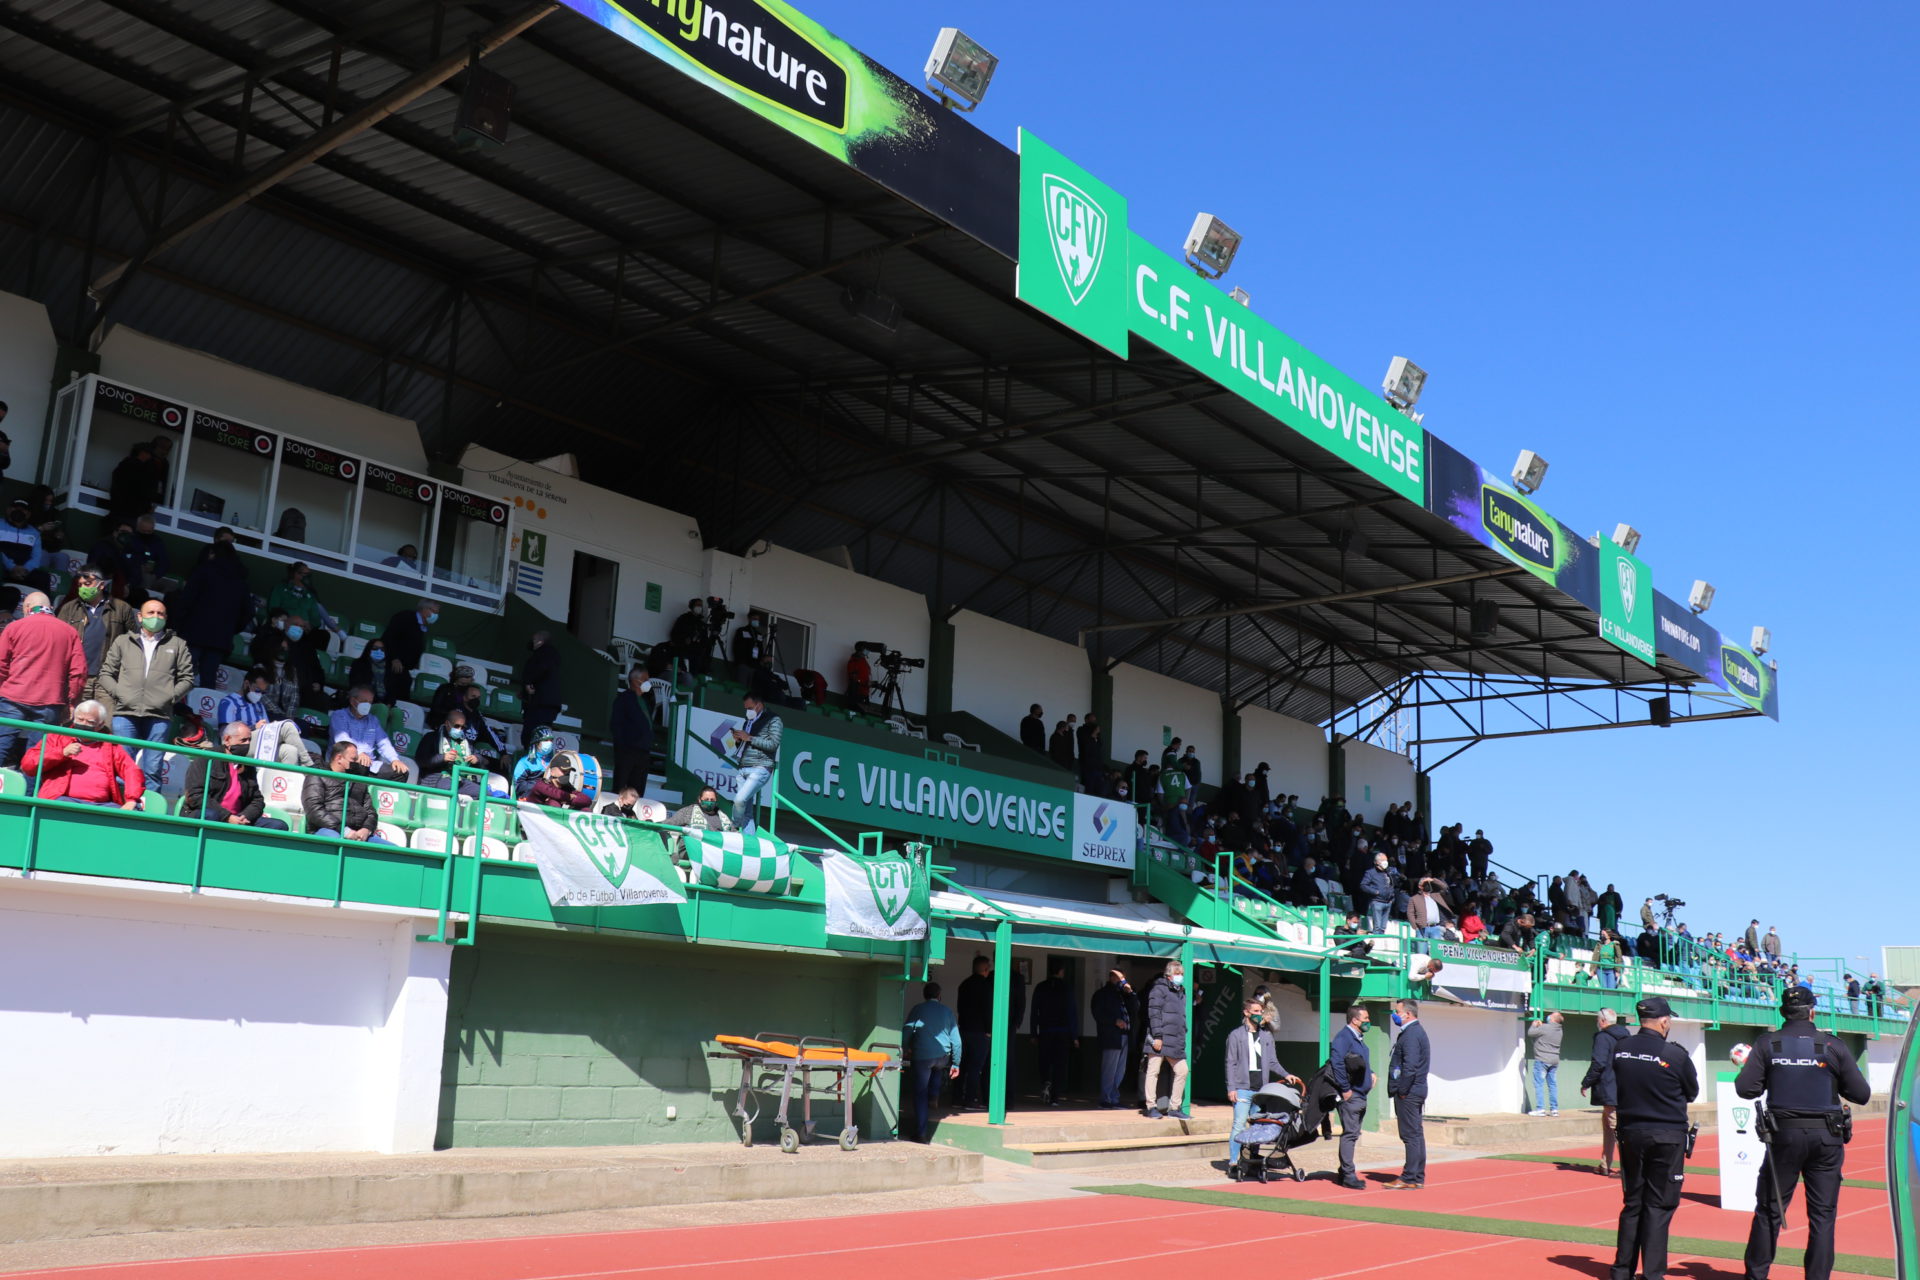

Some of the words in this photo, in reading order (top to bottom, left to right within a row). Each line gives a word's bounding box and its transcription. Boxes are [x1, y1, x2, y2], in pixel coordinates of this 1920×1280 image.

[1056, 191, 1098, 258] CFV
[1136, 264, 1194, 341] C.F.
[1204, 304, 1420, 483] VILLANOVENSE
[122, 403, 158, 423] STORE
[216, 432, 250, 450] STORE
[303, 458, 336, 476] STORE
[385, 483, 415, 498] STORE
[461, 504, 488, 519] STORE
[1490, 496, 1549, 558] tanynature
[1614, 624, 1654, 658] VILLANOVENSE
[694, 768, 738, 794] SEPR
[793, 751, 846, 799] C.F.
[858, 762, 1066, 841] VILLANOVENSE
[575, 814, 626, 847] CFV
[1082, 842, 1126, 863] SEPREX
[577, 890, 588, 901] de
[620, 888, 668, 900] Villanovense
[1771, 1058, 1819, 1066] POLICIA
